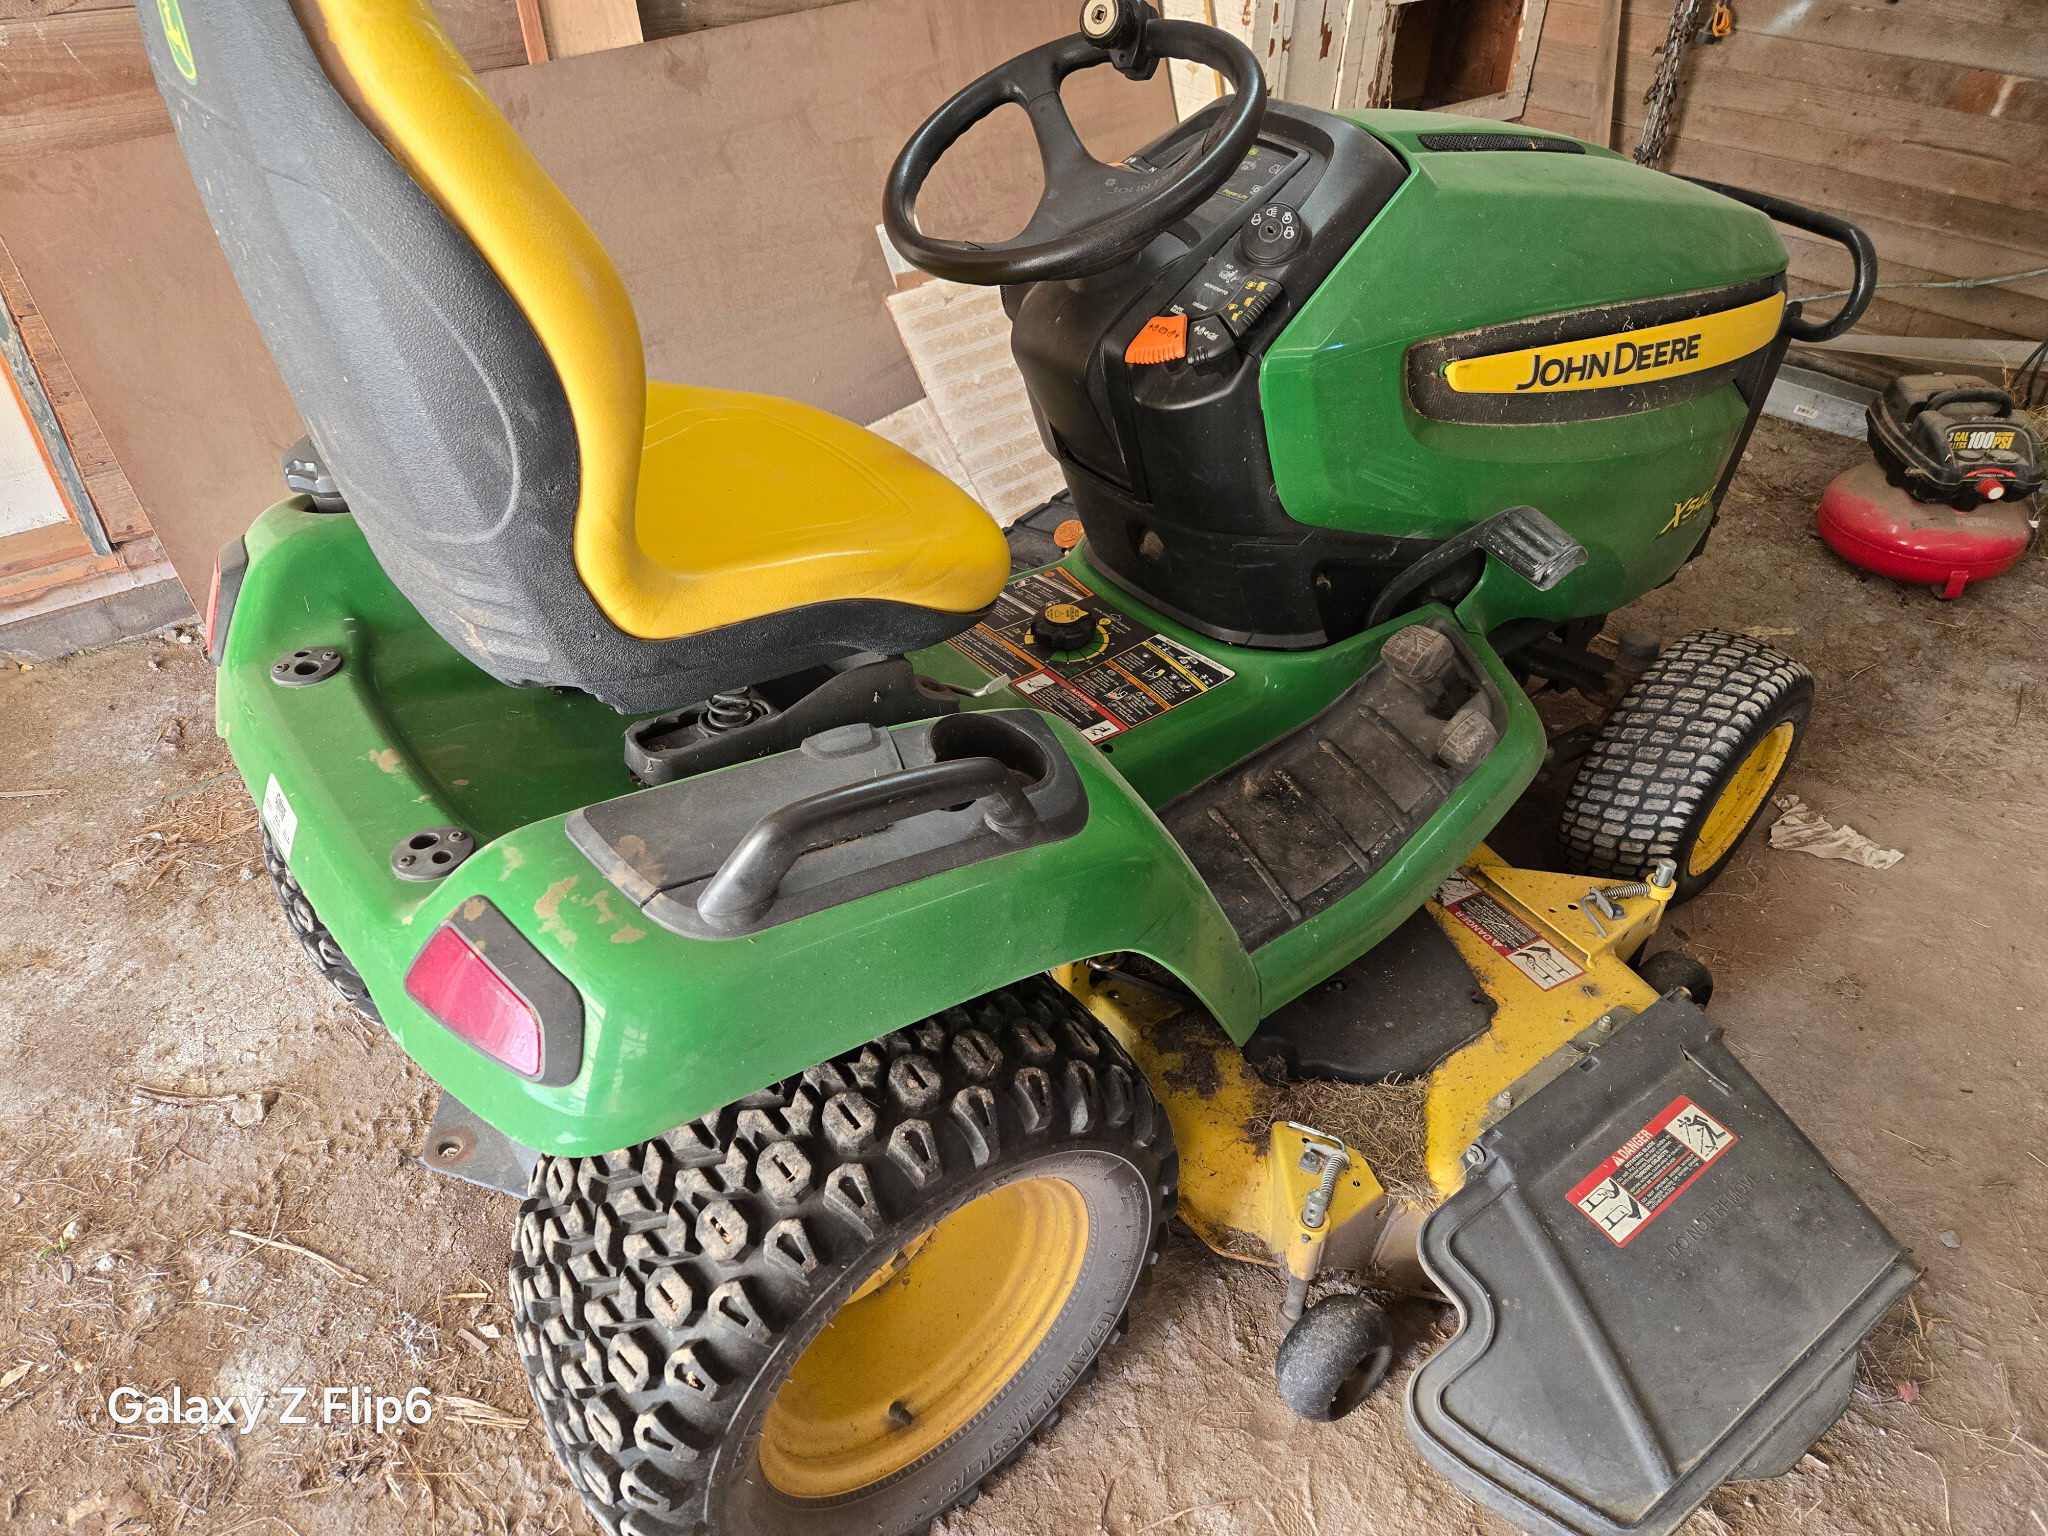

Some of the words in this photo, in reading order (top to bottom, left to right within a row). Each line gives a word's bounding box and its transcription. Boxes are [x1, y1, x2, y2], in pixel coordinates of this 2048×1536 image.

[1516, 350, 1611, 391] JOHN
[1612, 333, 1702, 376] DEERE
[1953, 431, 1968, 441] GAL
[1967, 431, 1995, 448] 100
[1991, 436, 2013, 449] PSI
[1455, 910, 1492, 941] DANGER
[1617, 1129, 1653, 1161] DANGER
[1664, 1236, 1691, 1260] DO
[1685, 1210, 1716, 1241] NOT
[1712, 1170, 1761, 1218] REMOVE
[940, 1311, 1115, 1504] CARLISLE
